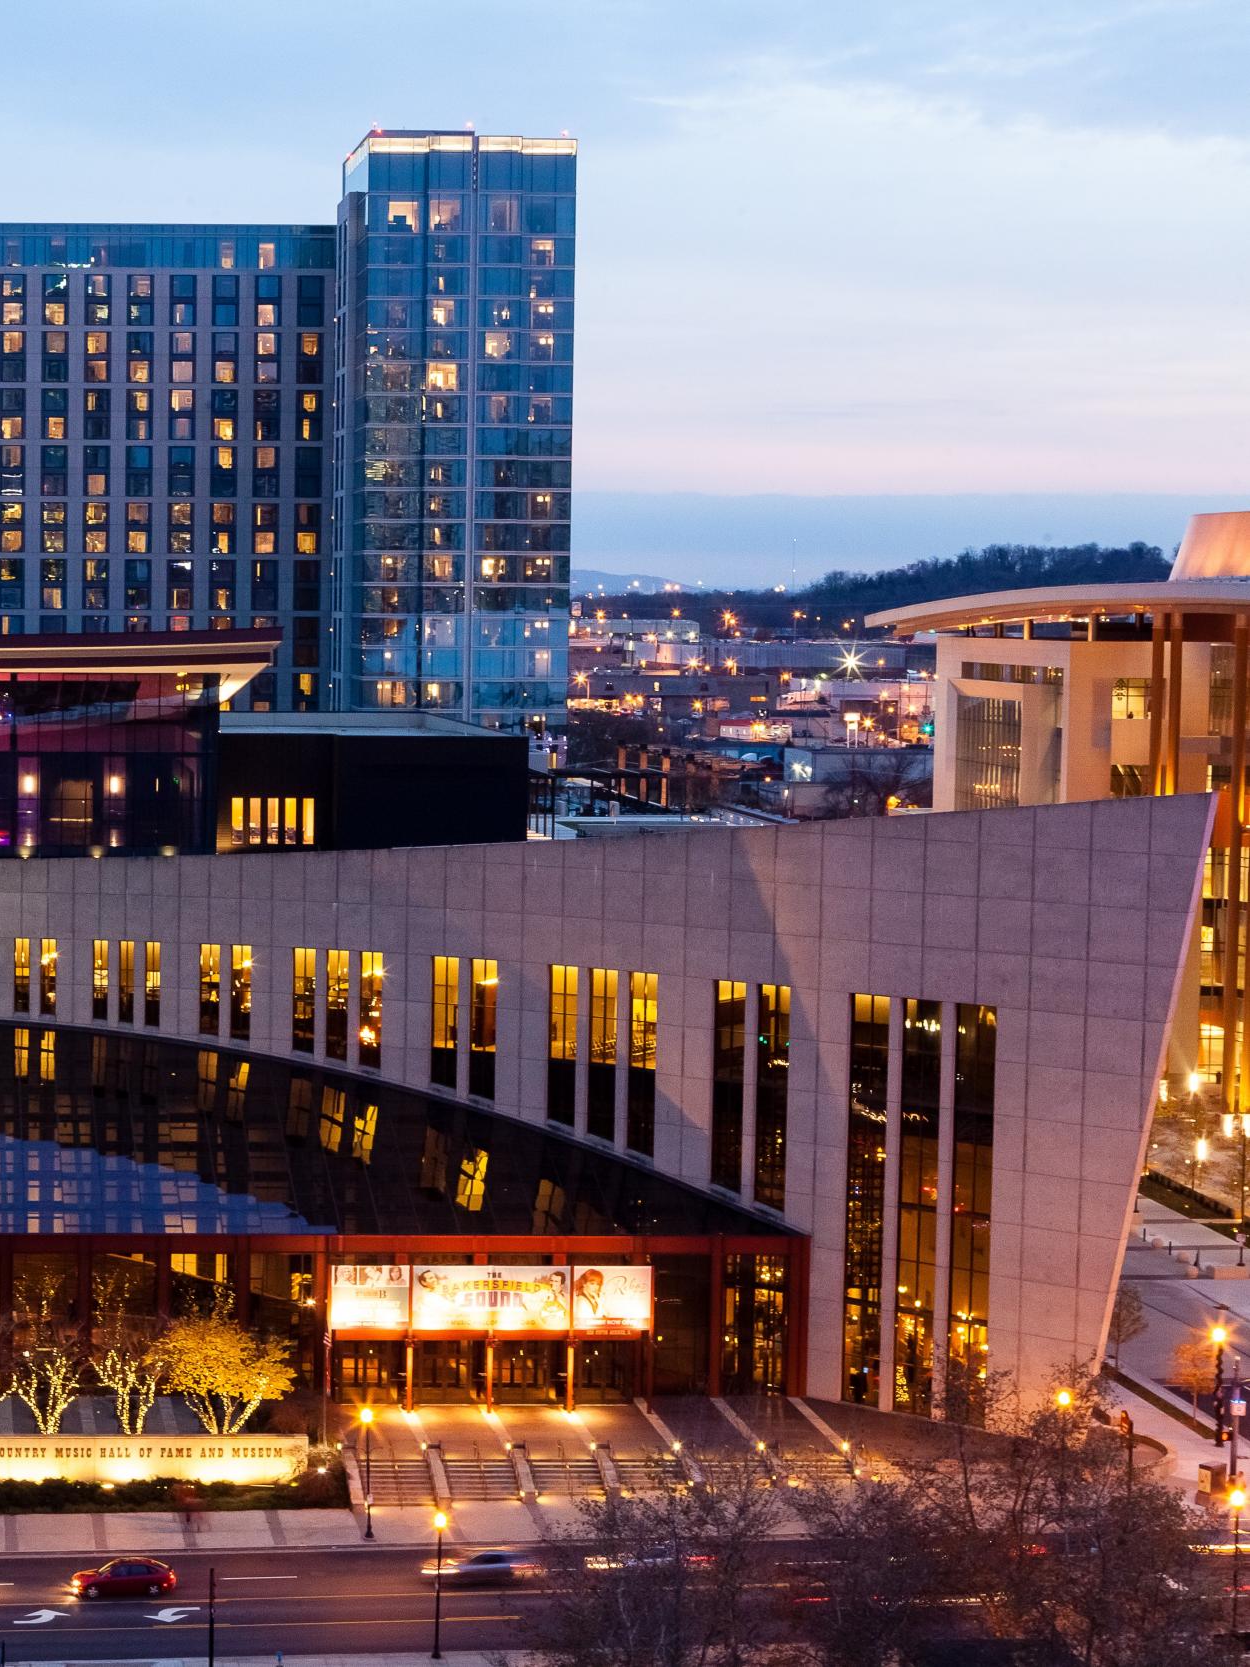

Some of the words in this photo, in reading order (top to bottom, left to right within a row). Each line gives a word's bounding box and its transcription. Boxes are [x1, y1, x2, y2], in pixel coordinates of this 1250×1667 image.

[442, 1280, 542, 1293] BAKERSFIELD
[462, 1291, 523, 1308] SOUND
[55, 1447, 92, 1458] MUSIC
[100, 1447, 131, 1458] HALL
[139, 1447, 153, 1458] OF
[160, 1447, 192, 1458] FAME
[200, 1447, 224, 1458] AND
[232, 1447, 283, 1458] MUSEUM
